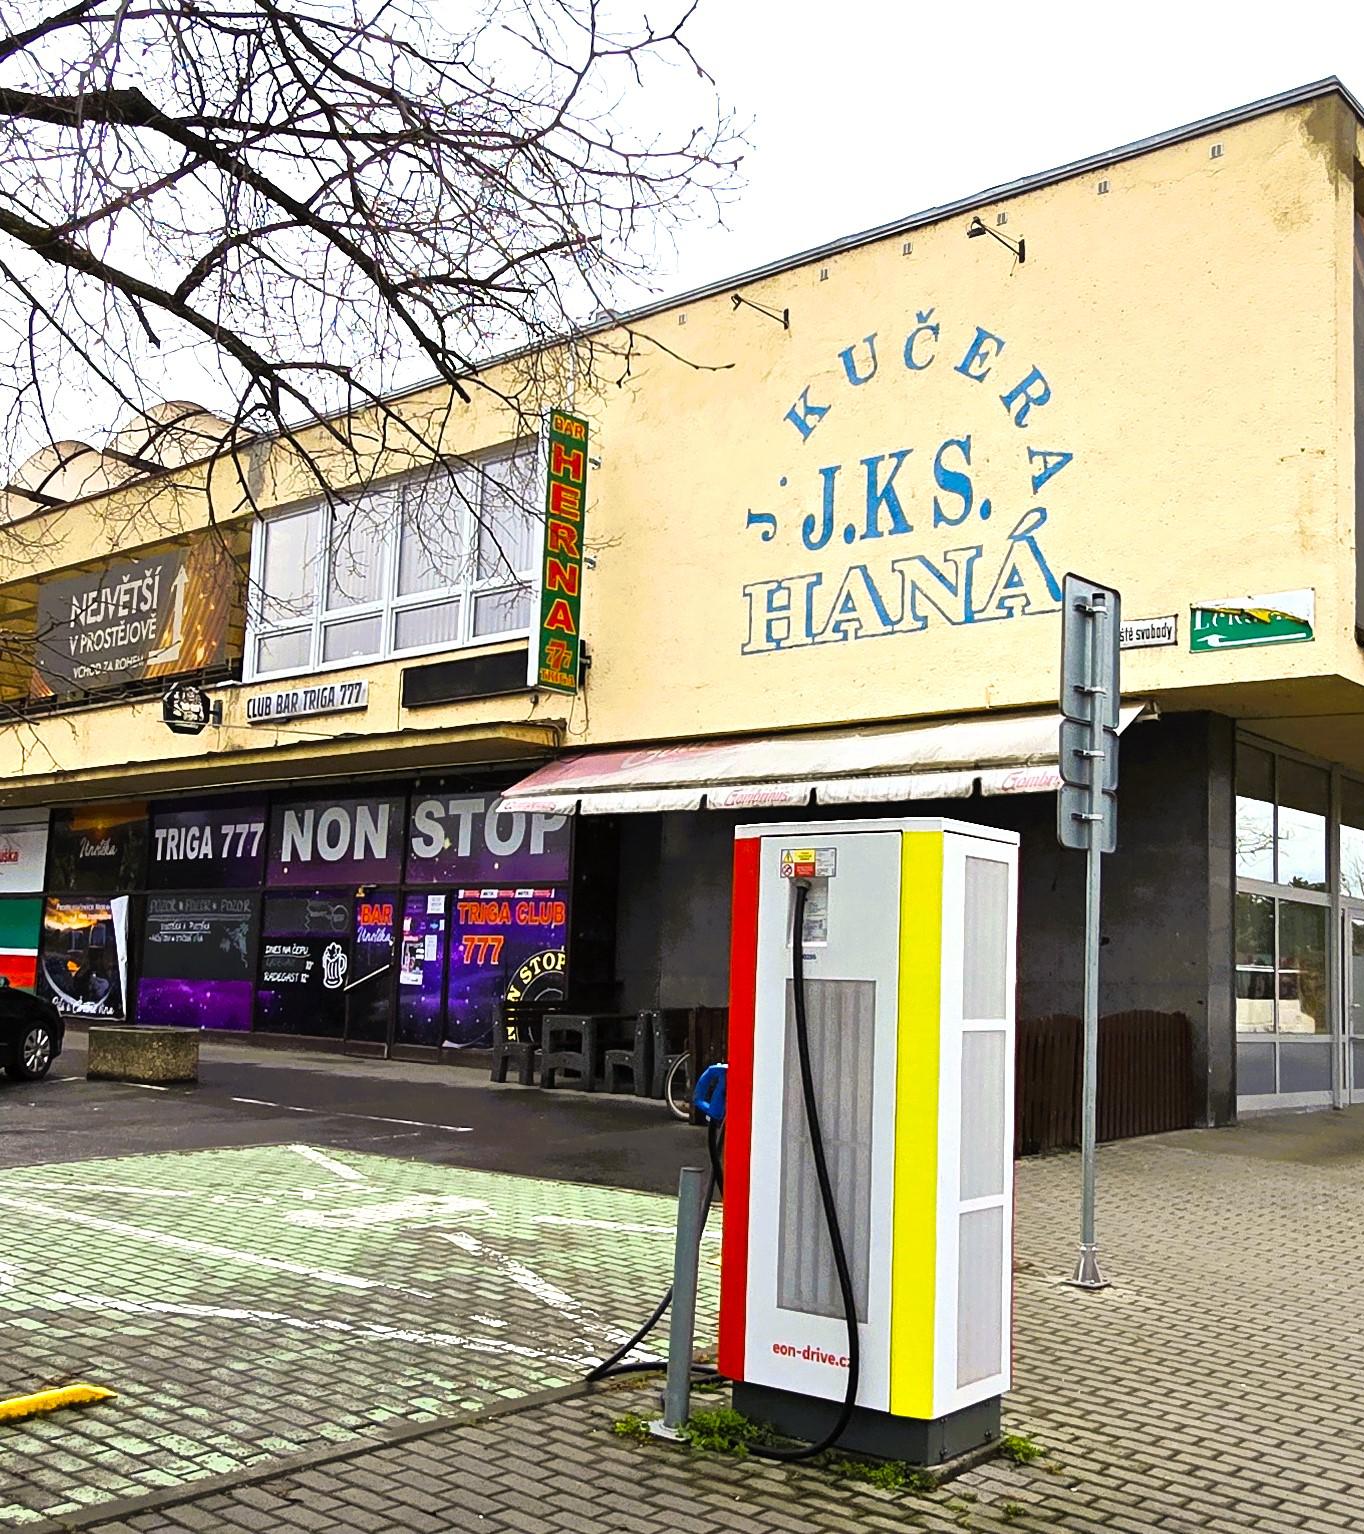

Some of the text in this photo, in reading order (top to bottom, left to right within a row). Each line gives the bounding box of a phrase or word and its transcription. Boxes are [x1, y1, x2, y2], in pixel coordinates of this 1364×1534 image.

[783, 308, 1074, 493] KUČERA
[553, 415, 586, 441] BAR
[544, 441, 584, 635] HERNA
[70, 565, 163, 628] NEJVĚTŠÍ
[741, 507, 1062, 656] HANÁ
[69, 613, 157, 656] V PROSTĚJOVĚ
[1135, 622, 1173, 641] svobody
[246, 681, 363, 719] CLUB BAR TRIGA 777
[154, 799, 568, 862] TRIGA 777 NON STOP
[360, 903, 393, 926] BAR
[457, 901, 511, 925] TRIGA
[515, 901, 565, 926] CLUB
[462, 935, 504, 965] 777
